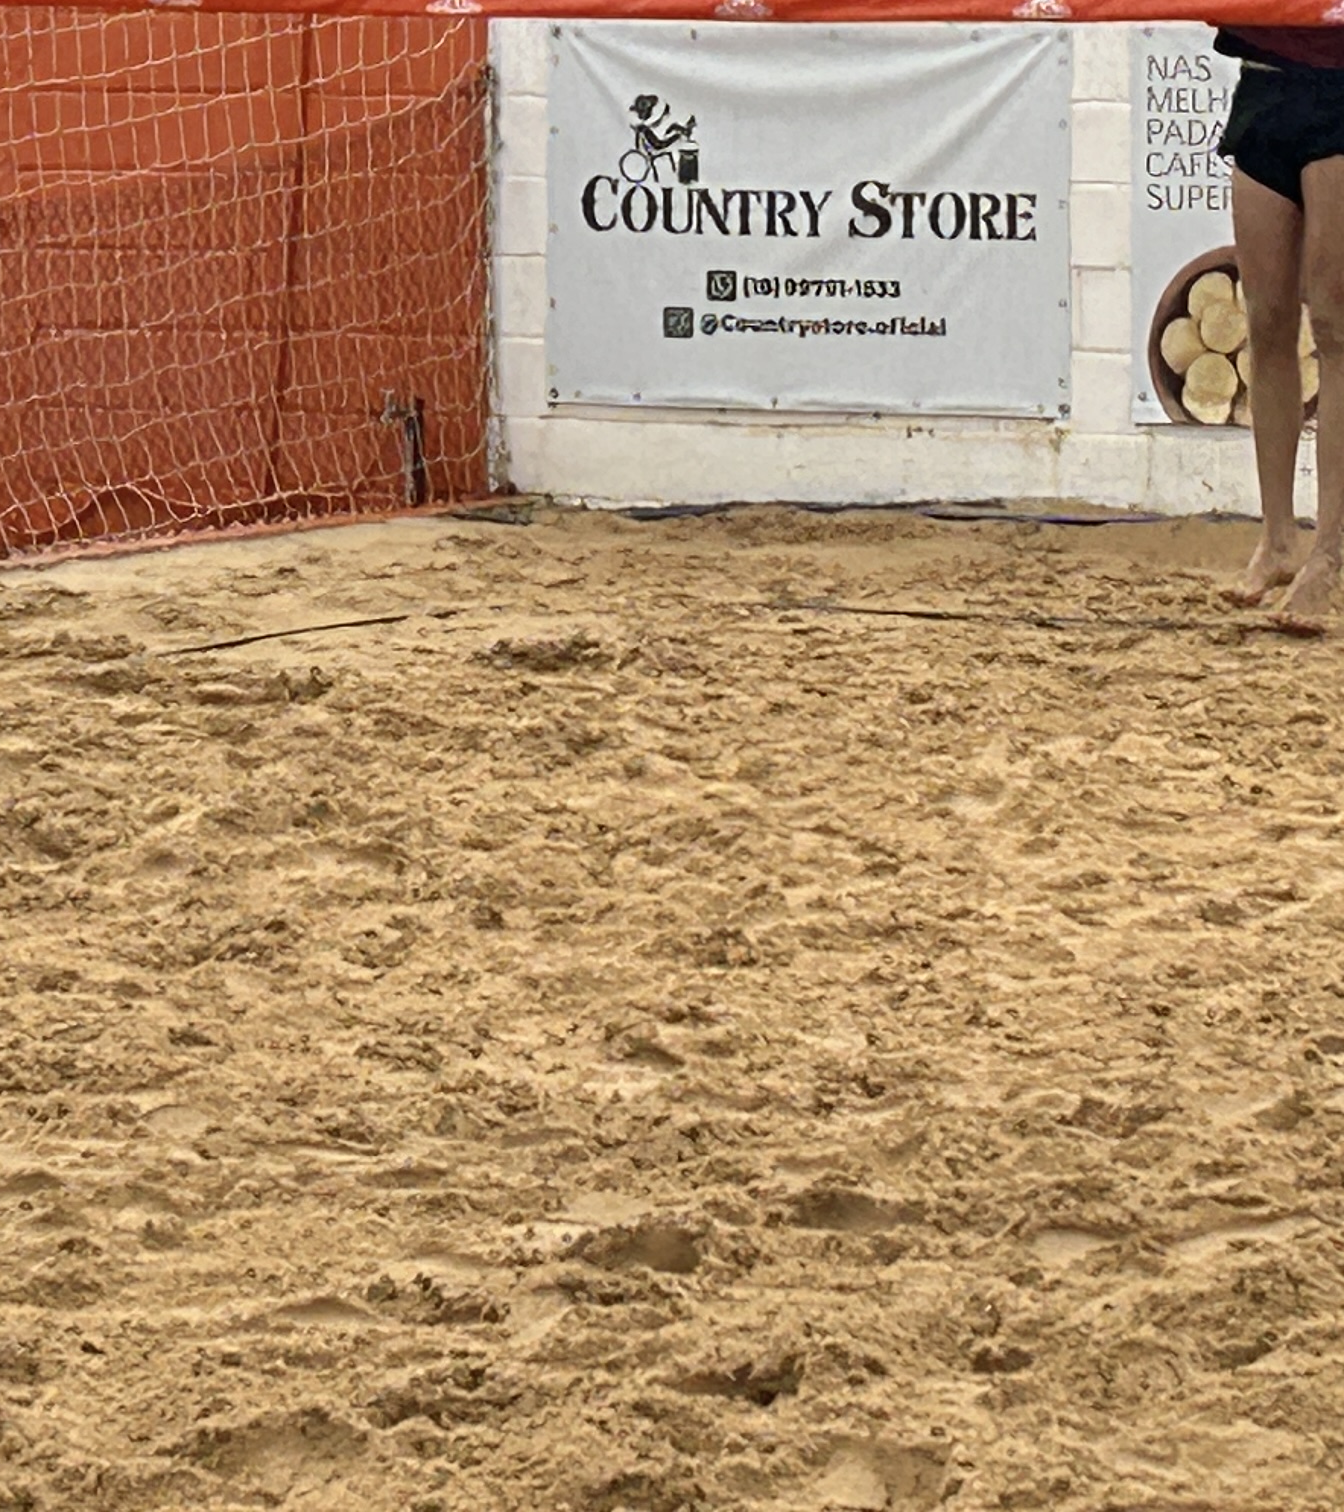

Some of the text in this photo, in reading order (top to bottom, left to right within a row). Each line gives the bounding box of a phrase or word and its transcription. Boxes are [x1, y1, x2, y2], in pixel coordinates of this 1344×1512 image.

[1147, 55, 1211, 81] NAS
[1146, 86, 1230, 113] MELH
[1146, 119, 1226, 146] PADA
[582, 175, 1037, 241] COUNTRY STORE
